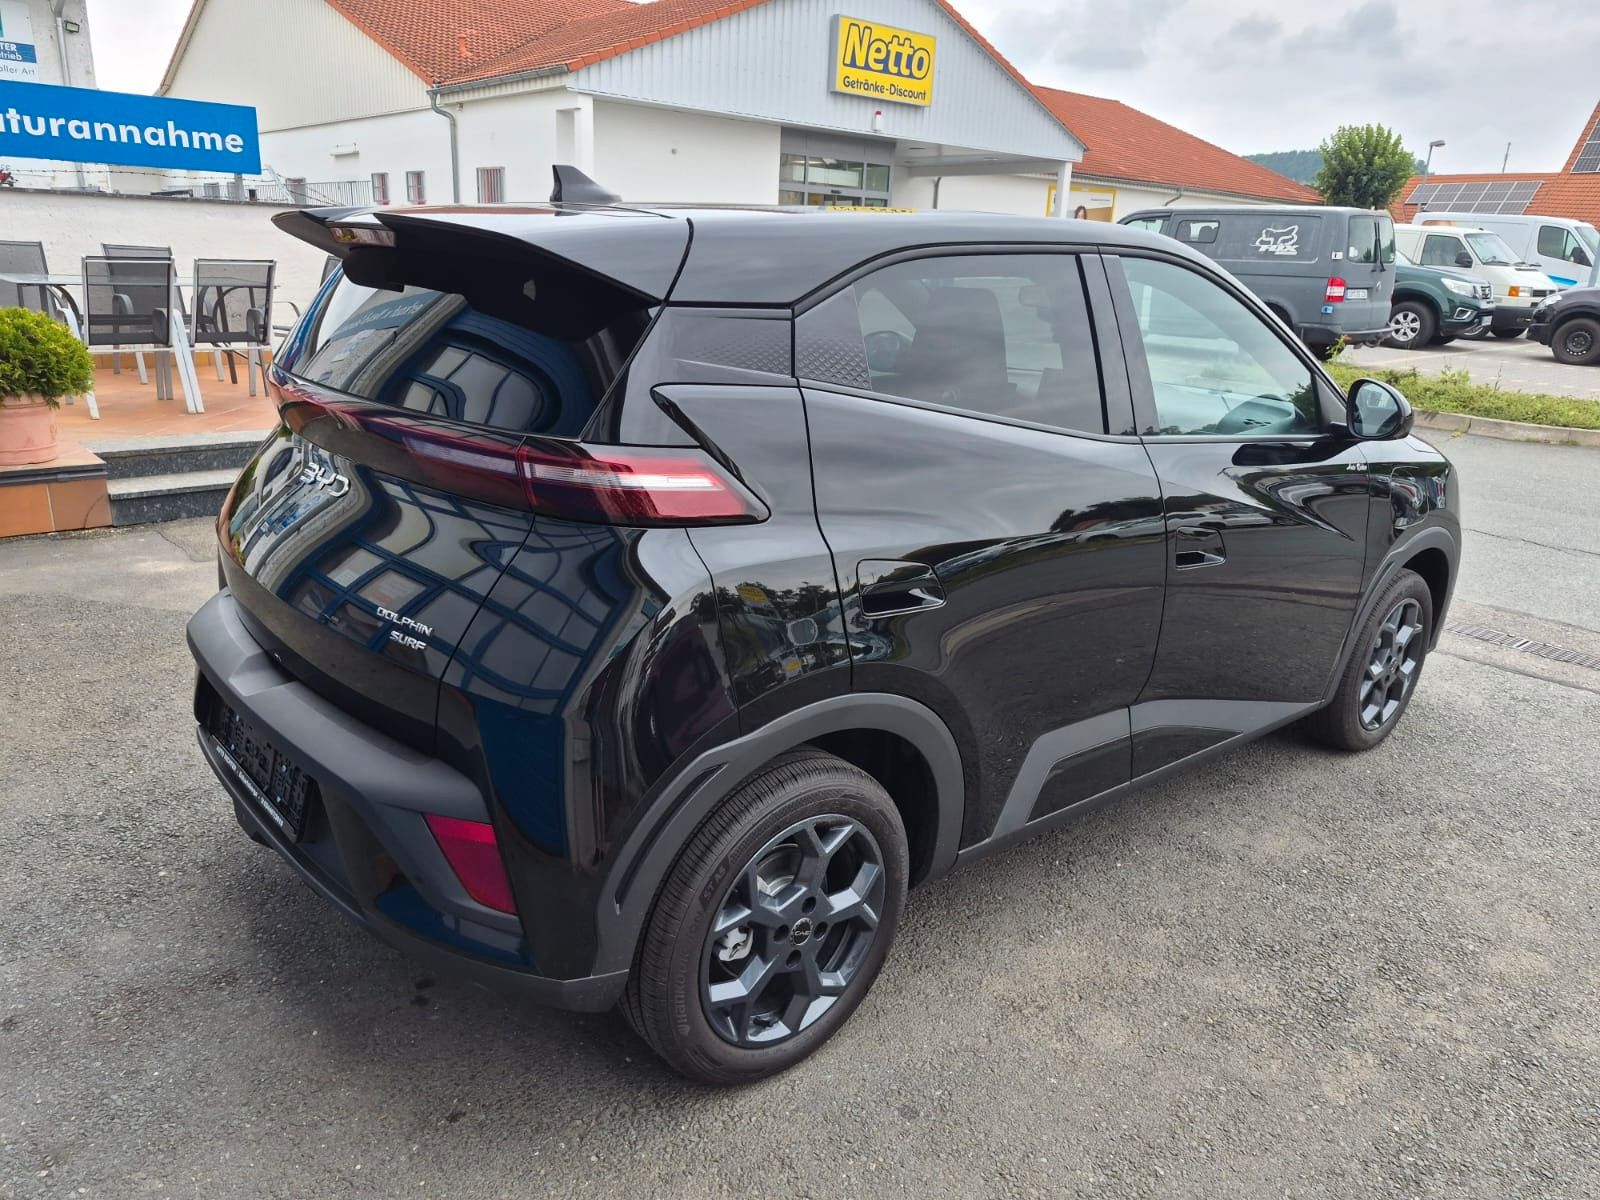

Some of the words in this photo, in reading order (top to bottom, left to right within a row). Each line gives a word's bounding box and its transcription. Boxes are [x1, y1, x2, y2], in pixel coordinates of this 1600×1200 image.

[843, 23, 931, 80] Netto
[843, 75, 927, 101] Getränke-Discount
[0, 107, 244, 153] turannahme
[301, 461, 350, 497] BYD
[376, 606, 433, 637] DOLPHIN
[389, 630, 427, 650] SURF
